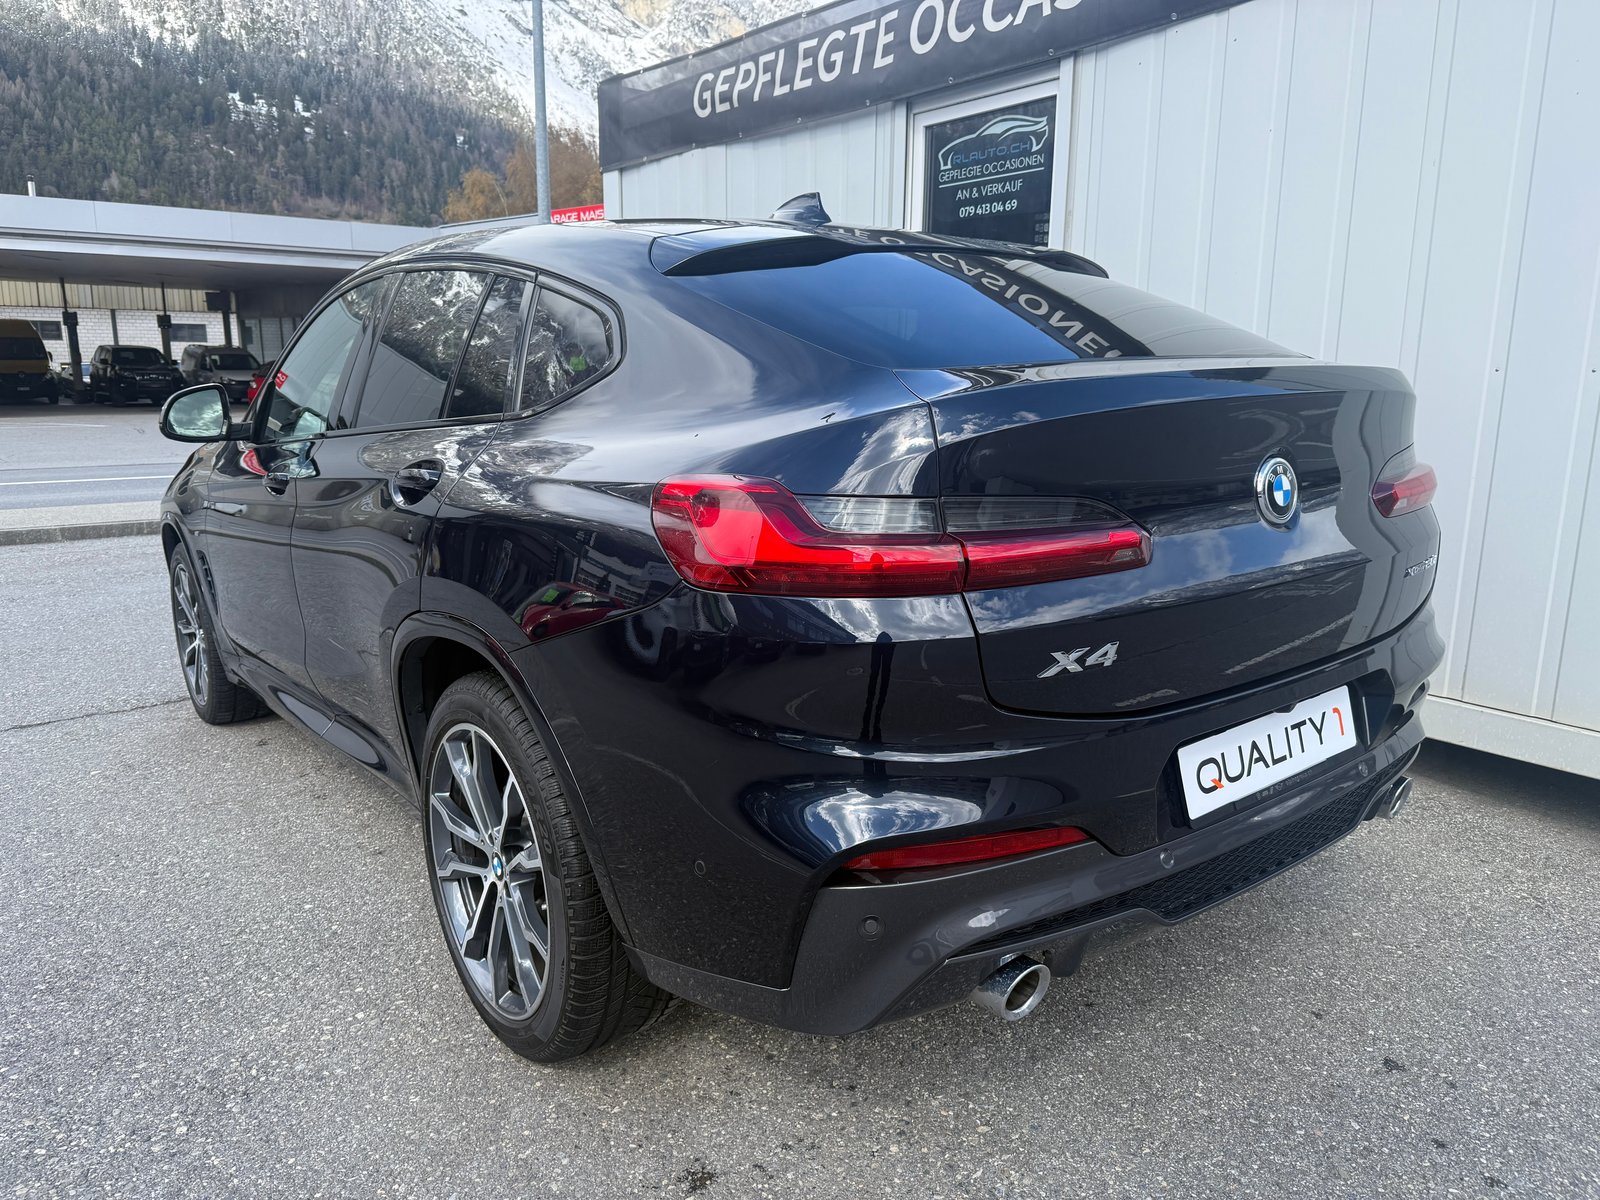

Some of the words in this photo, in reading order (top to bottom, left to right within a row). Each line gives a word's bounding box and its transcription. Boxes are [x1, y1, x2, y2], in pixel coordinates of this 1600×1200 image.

[693, 9, 899, 118] GEPFLEGTE
[910, 0, 1082, 55] OCC
[953, 141, 1030, 164] RLAUTO.CH
[939, 165, 982, 182] GEPFLEGTE
[983, 153, 1045, 174] OCCASIONEN
[955, 189, 970, 200] AN
[971, 187, 979, 198] &
[981, 179, 1023, 196] VERKAUF
[959, 206, 975, 217] 079
[976, 203, 990, 215] 413
[991, 201, 1004, 213] 04
[1005, 199, 1018, 211] 69
[1036, 640, 1120, 679] X4
